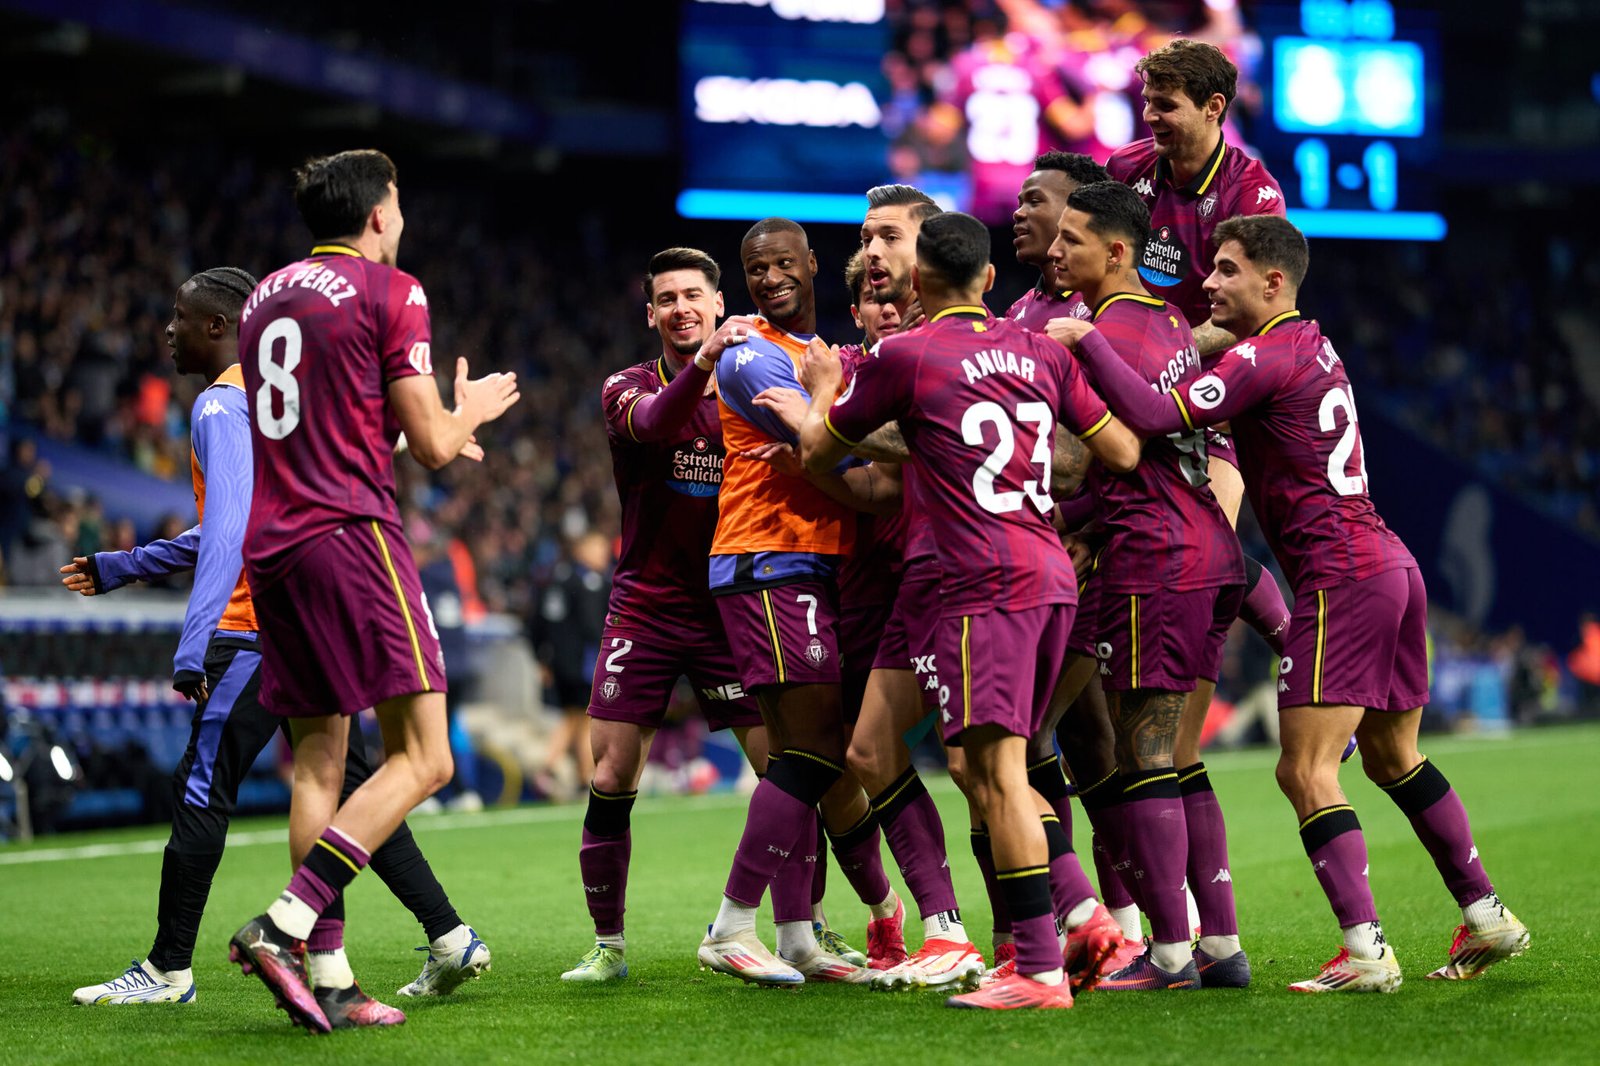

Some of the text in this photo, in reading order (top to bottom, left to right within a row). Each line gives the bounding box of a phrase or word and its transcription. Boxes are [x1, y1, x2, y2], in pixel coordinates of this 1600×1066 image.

[1143, 251, 1177, 275] Galicia
[242, 265, 357, 323] KIKE PÉREZ
[256, 316, 303, 440] 8
[960, 349, 1036, 385] ANUAR
[673, 464, 722, 483] Galicia
[960, 401, 1055, 515] 23
[796, 594, 818, 635] 7
[605, 638, 633, 673] 2
